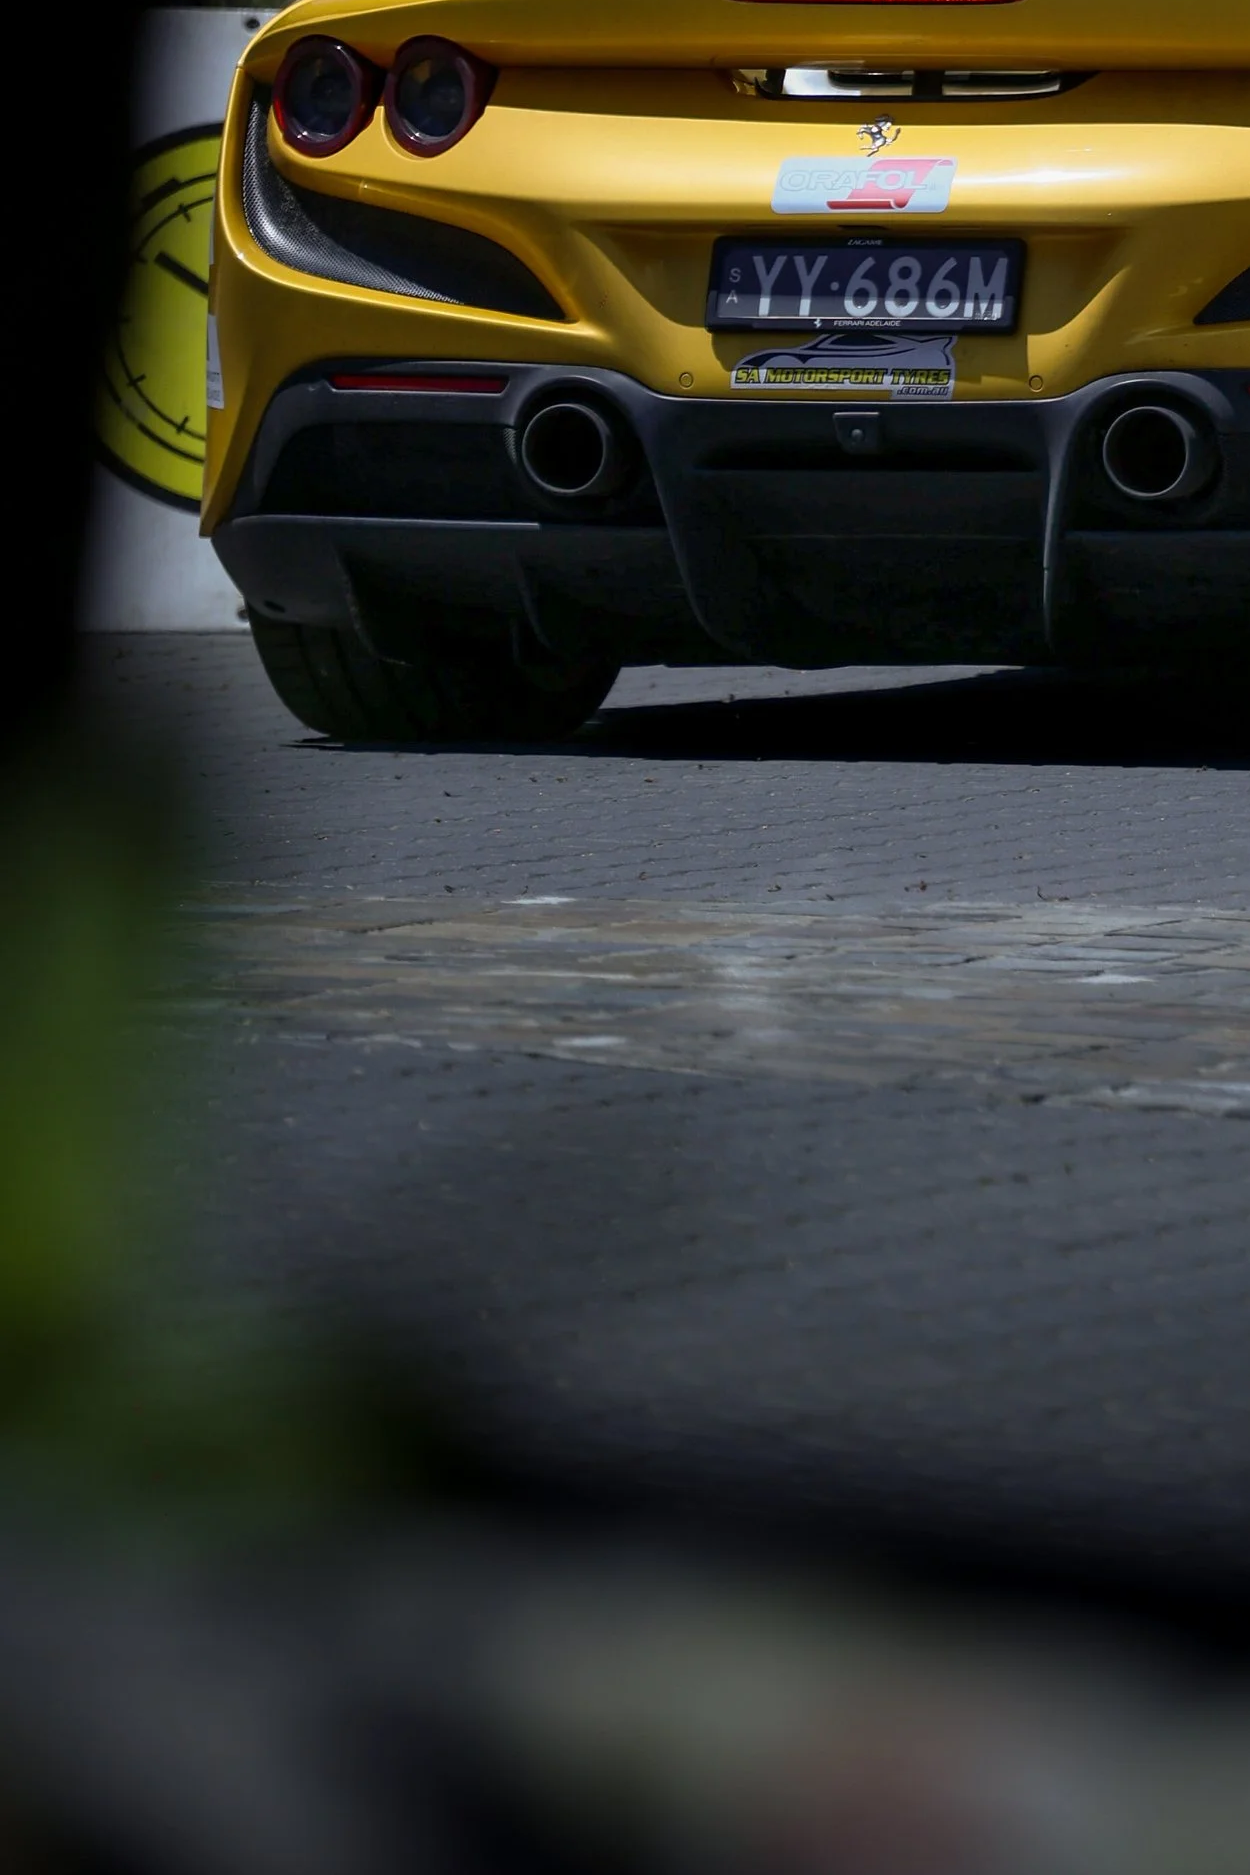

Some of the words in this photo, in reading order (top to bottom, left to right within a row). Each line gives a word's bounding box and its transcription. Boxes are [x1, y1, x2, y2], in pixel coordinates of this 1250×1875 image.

[779, 169, 928, 192] ORAFOL
[735, 368, 761, 384] SA
[765, 368, 887, 385] MOTORSPORT
[891, 368, 952, 386] TYRES
[897, 386, 949, 396] .com.au
